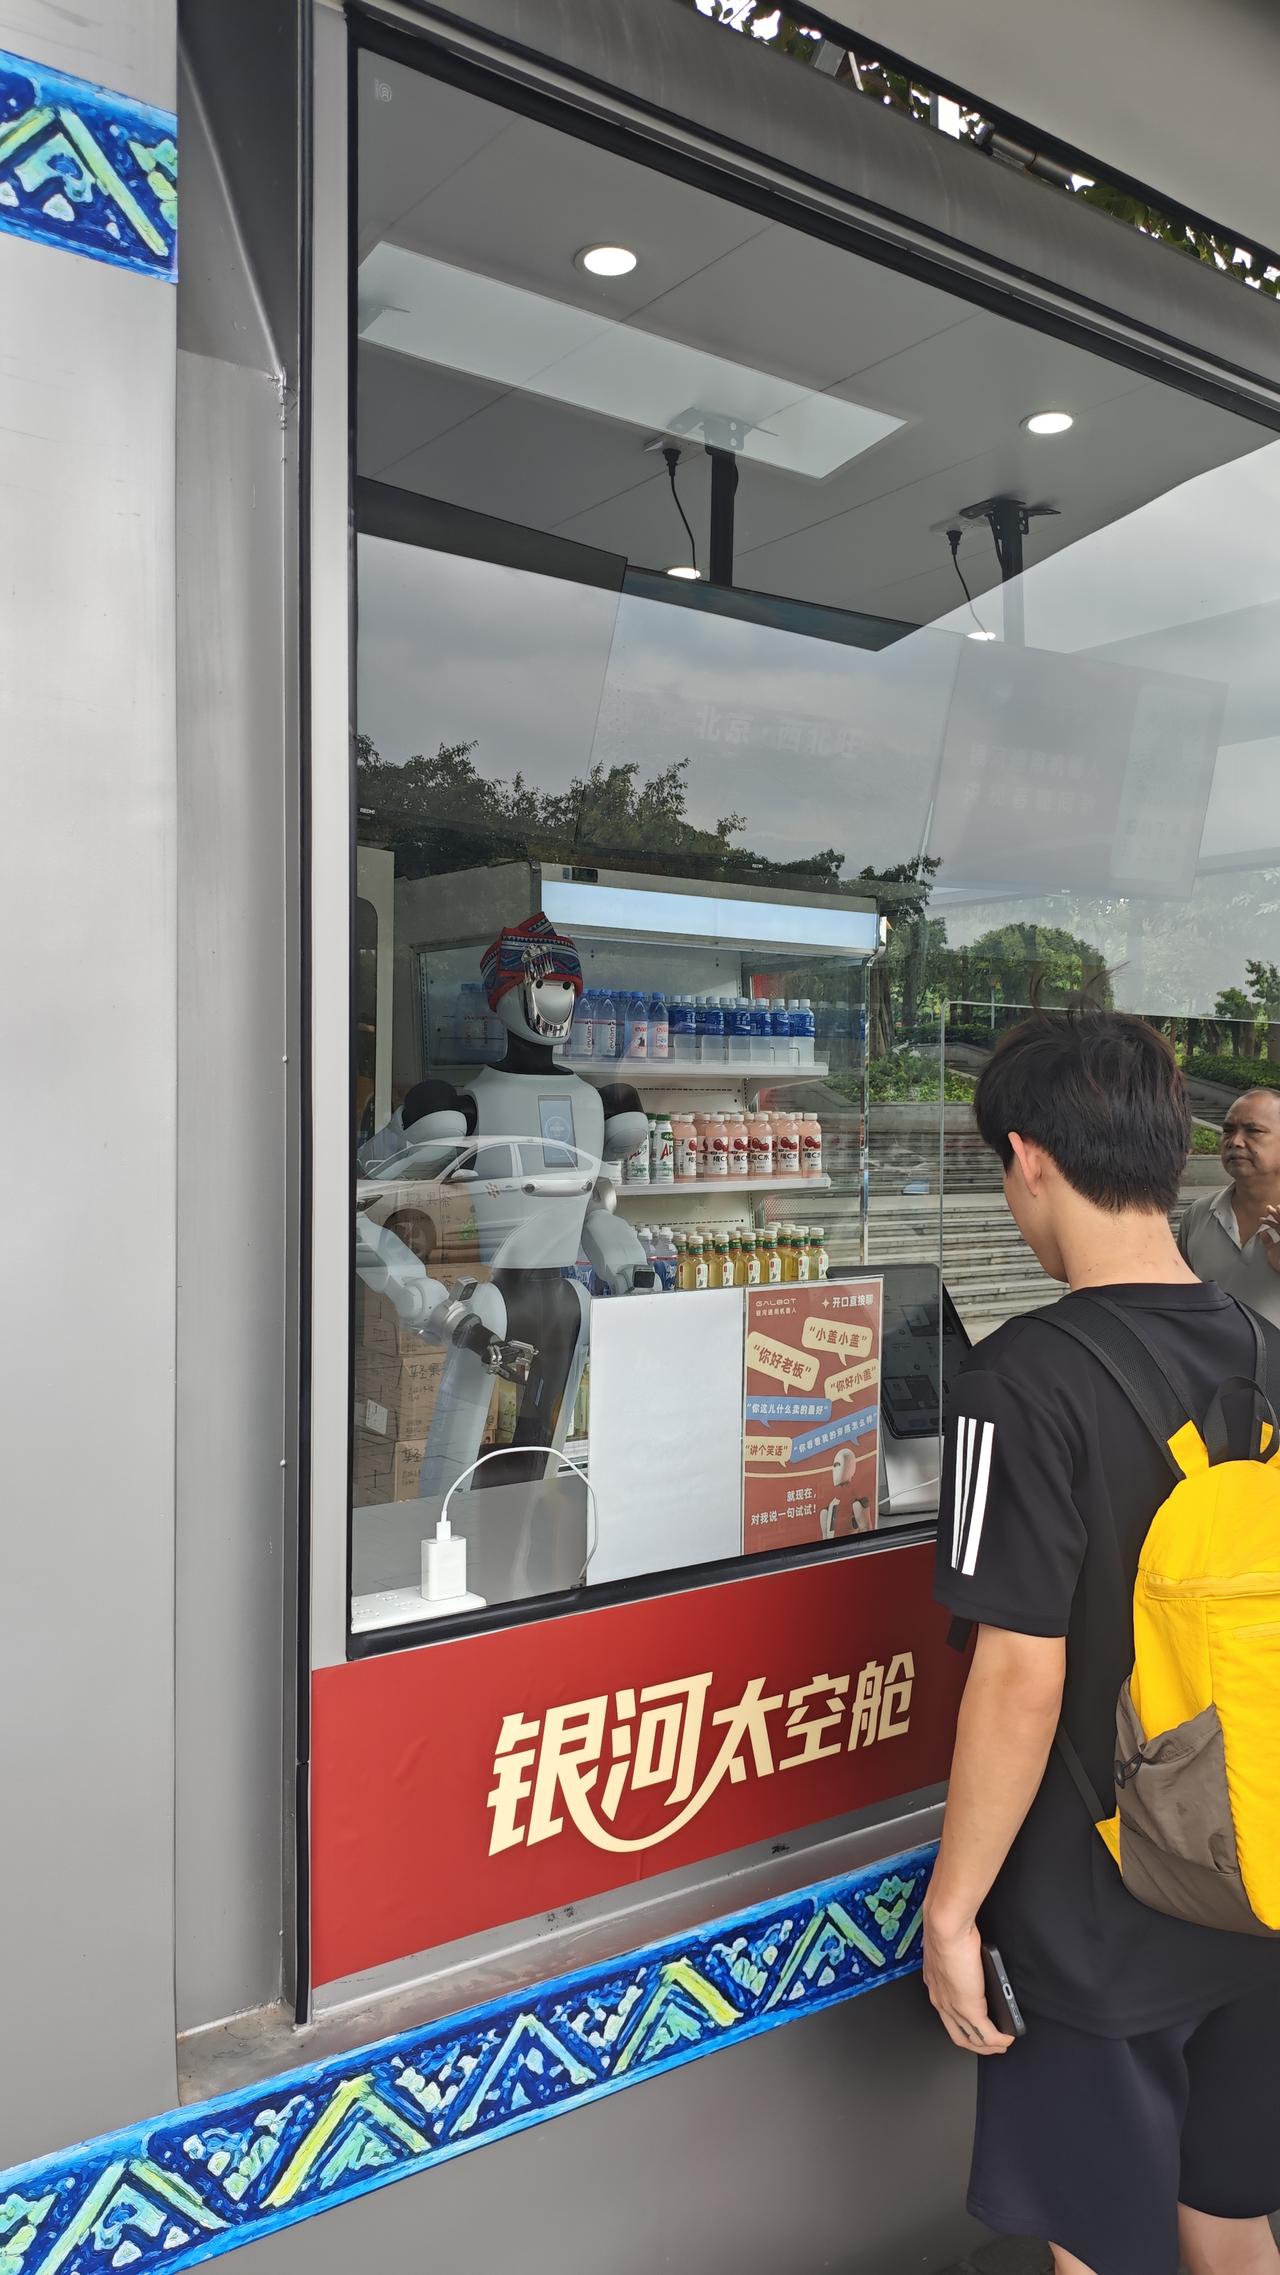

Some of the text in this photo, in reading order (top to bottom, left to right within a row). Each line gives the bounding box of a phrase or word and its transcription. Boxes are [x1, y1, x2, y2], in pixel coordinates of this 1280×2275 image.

[756, 1298, 797, 1307] GALBOT
[833, 1294, 874, 1309] 开口直接聊
[486, 1650, 916, 1858] 银河太空舱
